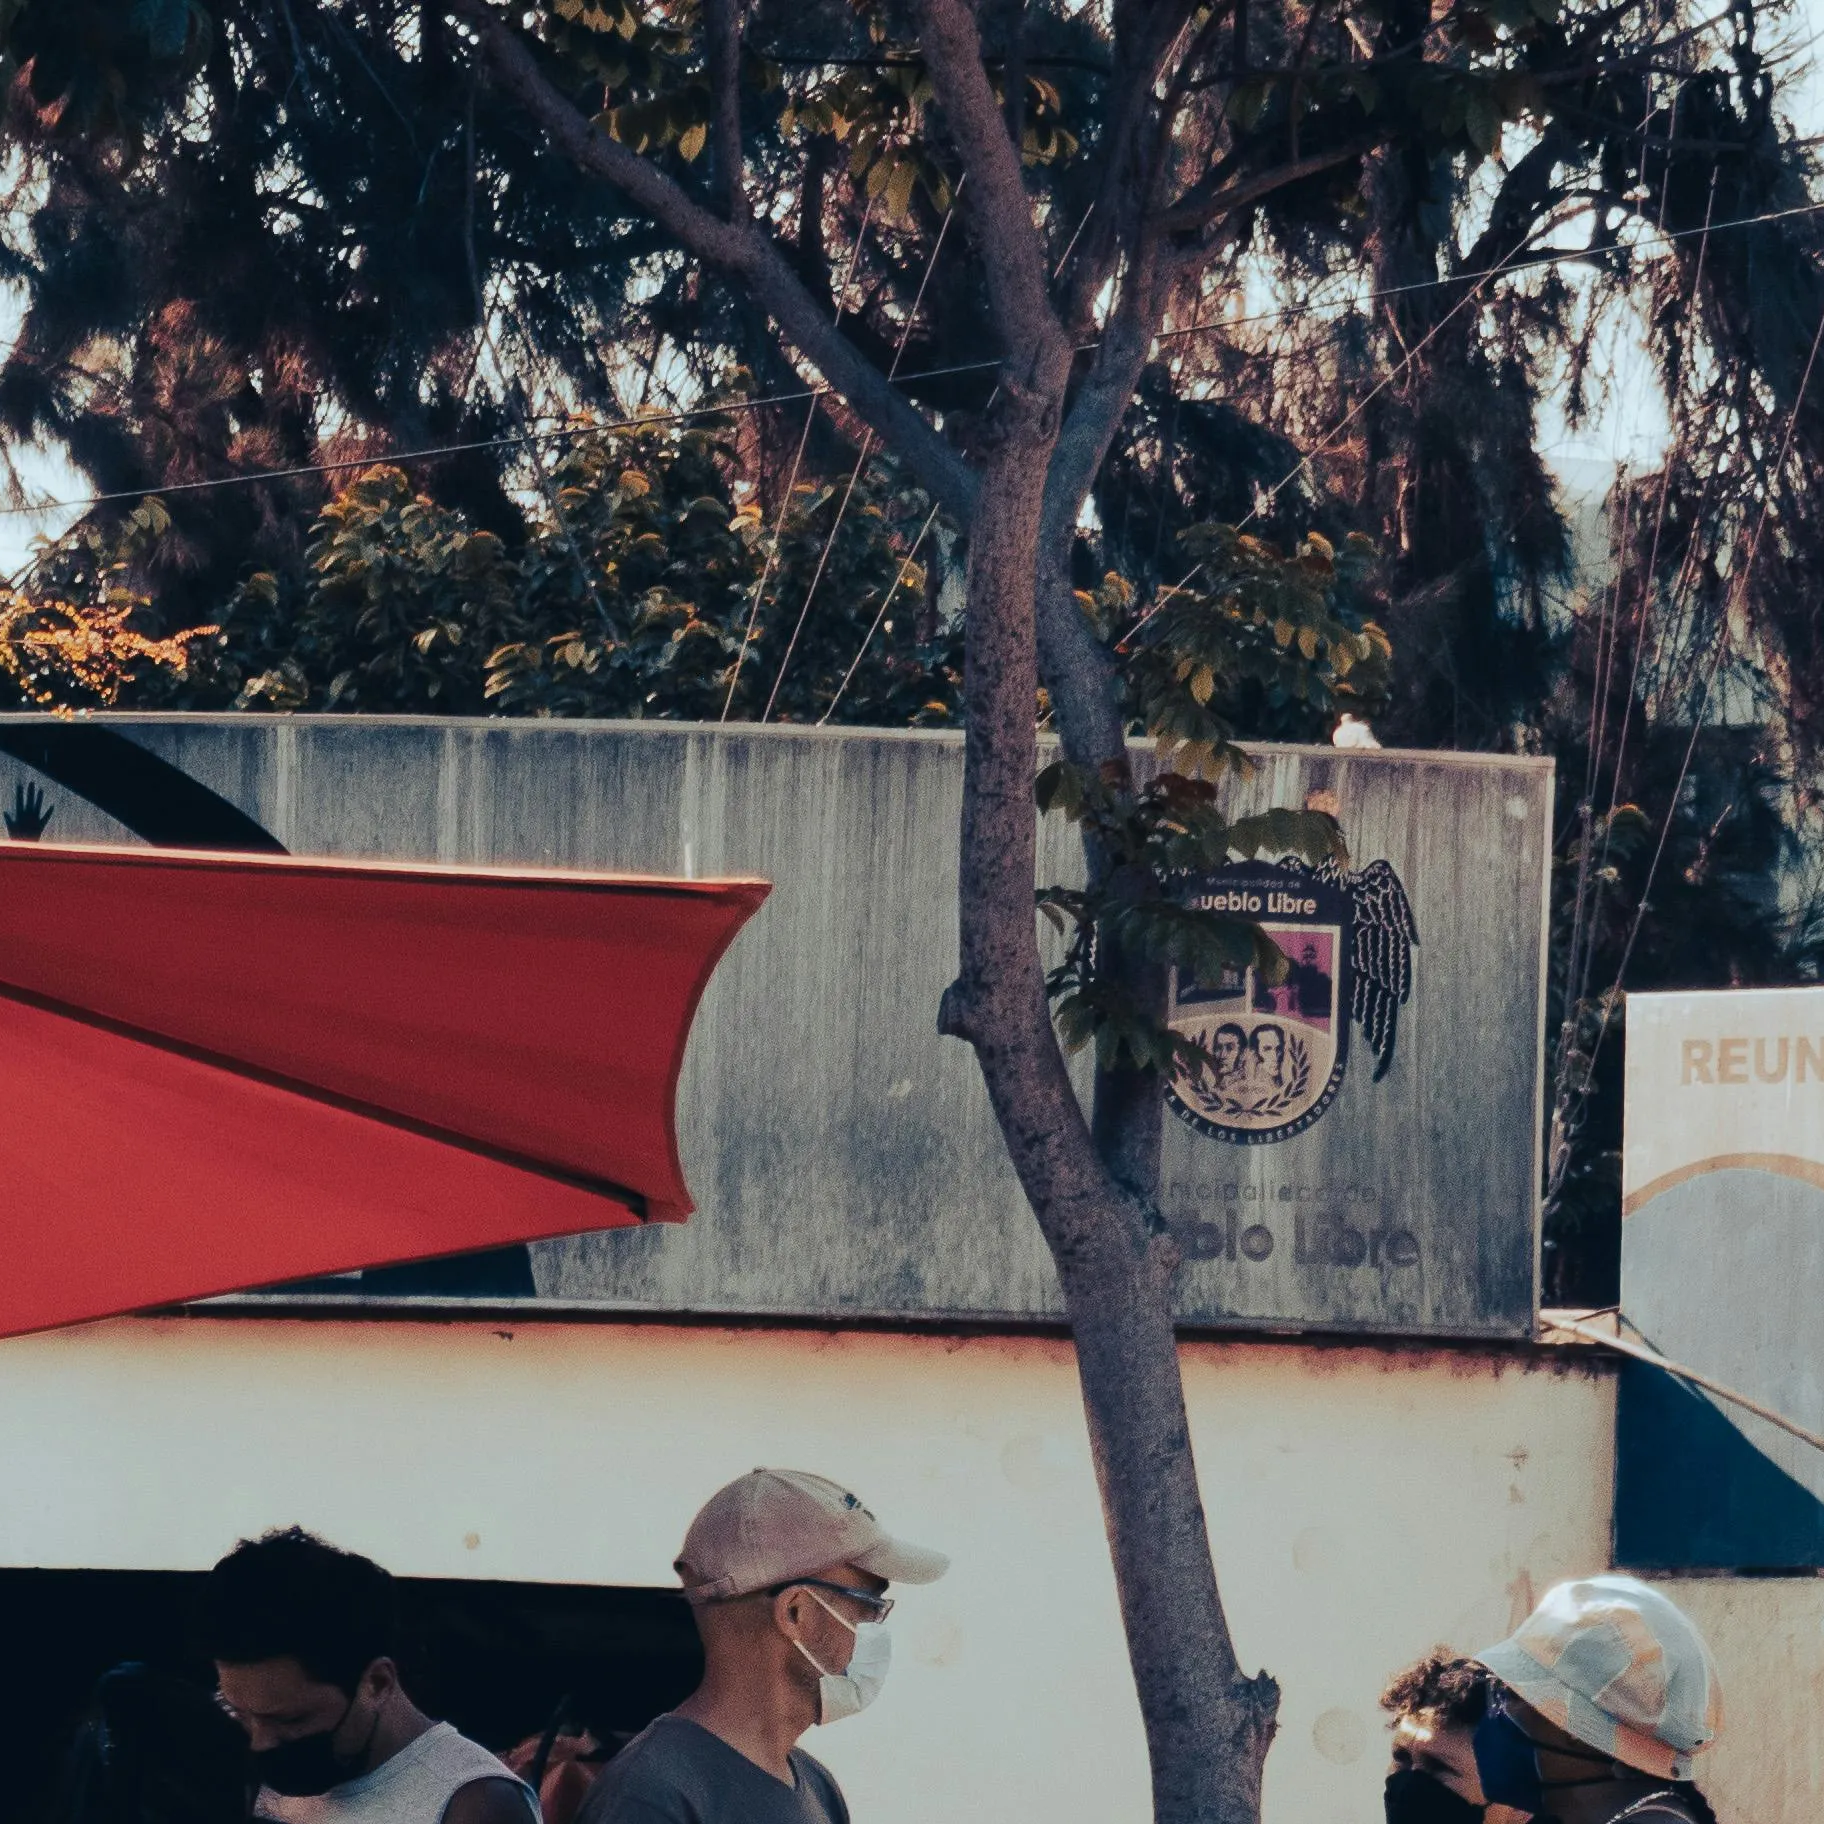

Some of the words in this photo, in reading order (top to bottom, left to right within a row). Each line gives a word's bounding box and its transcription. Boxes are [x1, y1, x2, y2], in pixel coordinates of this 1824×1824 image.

[1192, 890, 1262, 913] ueblo
[1267, 891, 1318, 915] Libre
[1186, 1209, 1274, 1263] blo
